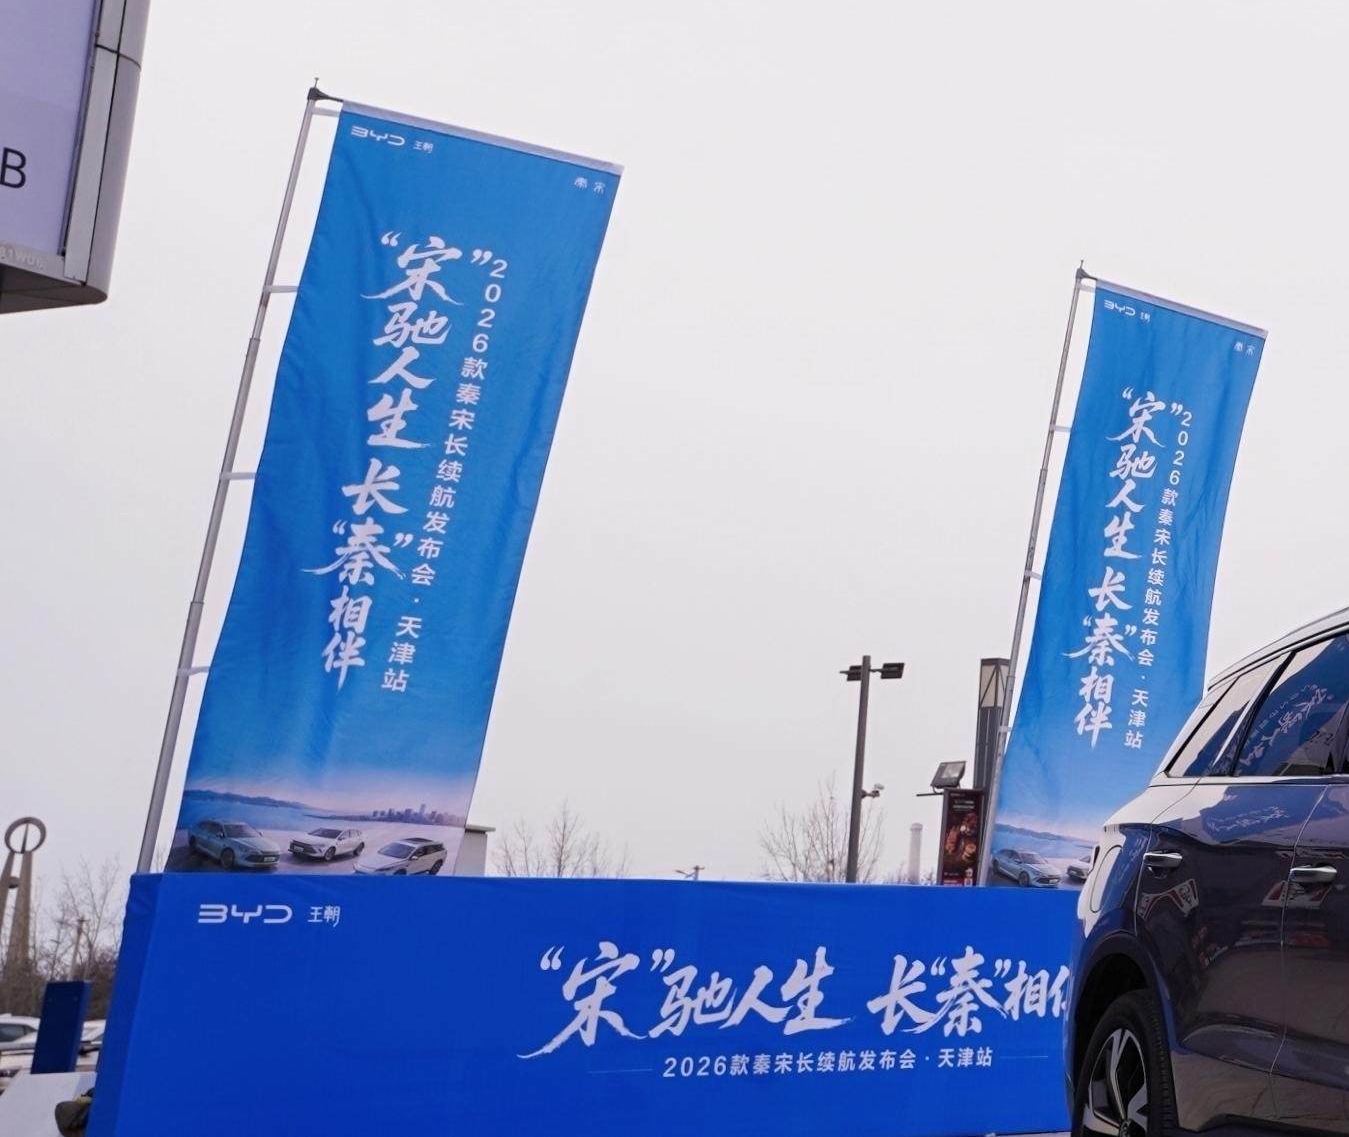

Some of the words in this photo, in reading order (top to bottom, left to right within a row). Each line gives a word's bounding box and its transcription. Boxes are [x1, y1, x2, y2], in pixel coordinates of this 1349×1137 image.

[351, 125, 405, 146] BYD
[1104, 299, 1137, 317] BYD
[198, 904, 293, 924] BYD
[308, 905, 340, 927] 王朝
